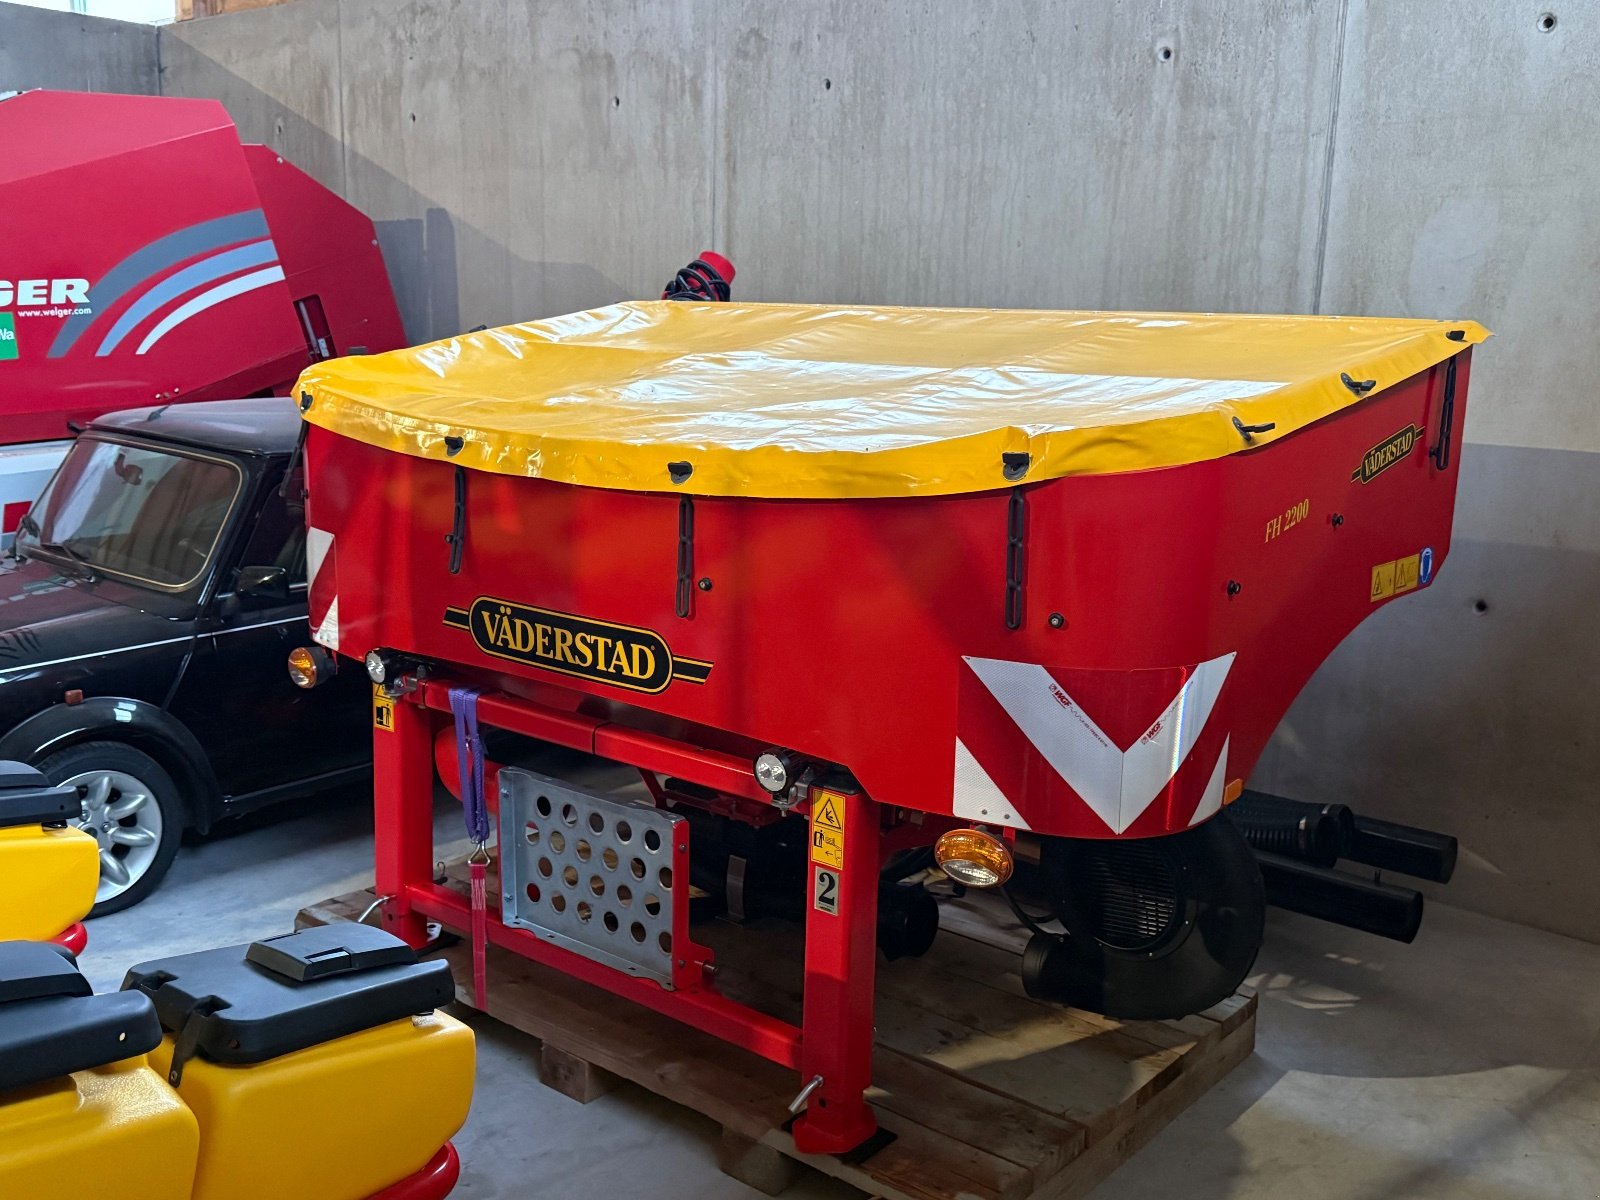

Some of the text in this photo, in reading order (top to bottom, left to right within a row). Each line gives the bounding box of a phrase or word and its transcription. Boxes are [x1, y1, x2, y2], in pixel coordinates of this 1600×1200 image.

[18, 306, 92, 318] www.welger.com
[1364, 432, 1412, 476] VÄDERSTAD
[1264, 499, 1309, 543] FH 2200
[481, 605, 656, 680] VÄDERSTAD
[1054, 690, 1072, 707] WGF
[818, 872, 836, 906] 2
